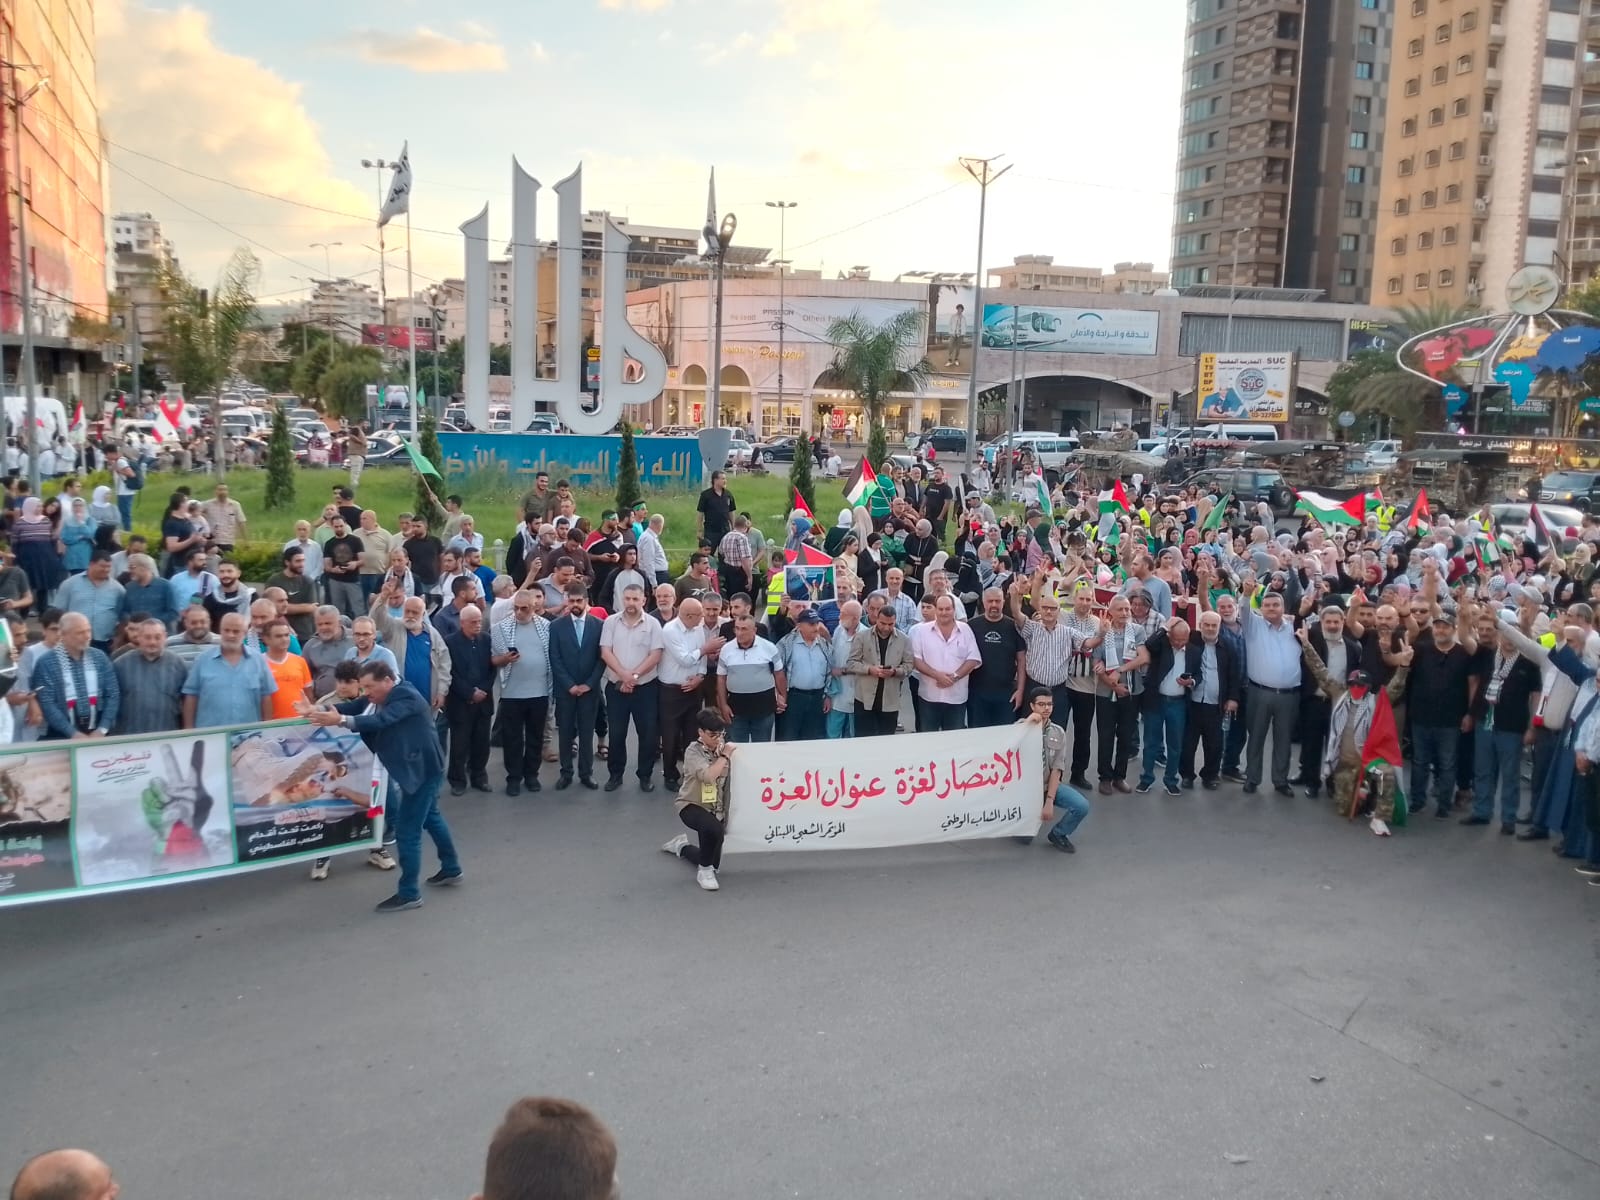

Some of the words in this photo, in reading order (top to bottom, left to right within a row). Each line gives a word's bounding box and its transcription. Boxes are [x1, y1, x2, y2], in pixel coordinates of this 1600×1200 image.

[1266, 357, 1286, 365] SUC
[651, 450, 691, 479] الله
[820, 766, 886, 809] عنوان
[278, 826, 299, 836] تحت
[819, 820, 845, 839] المؤتمر
[941, 811, 970, 832] الوطني
[248, 826, 277, 843] أقدام
[297, 833, 324, 846] الشعب
[764, 823, 795, 843] اللبناني
[792, 822, 823, 843] الشعبي
[248, 838, 297, 856] الفلسطيني
